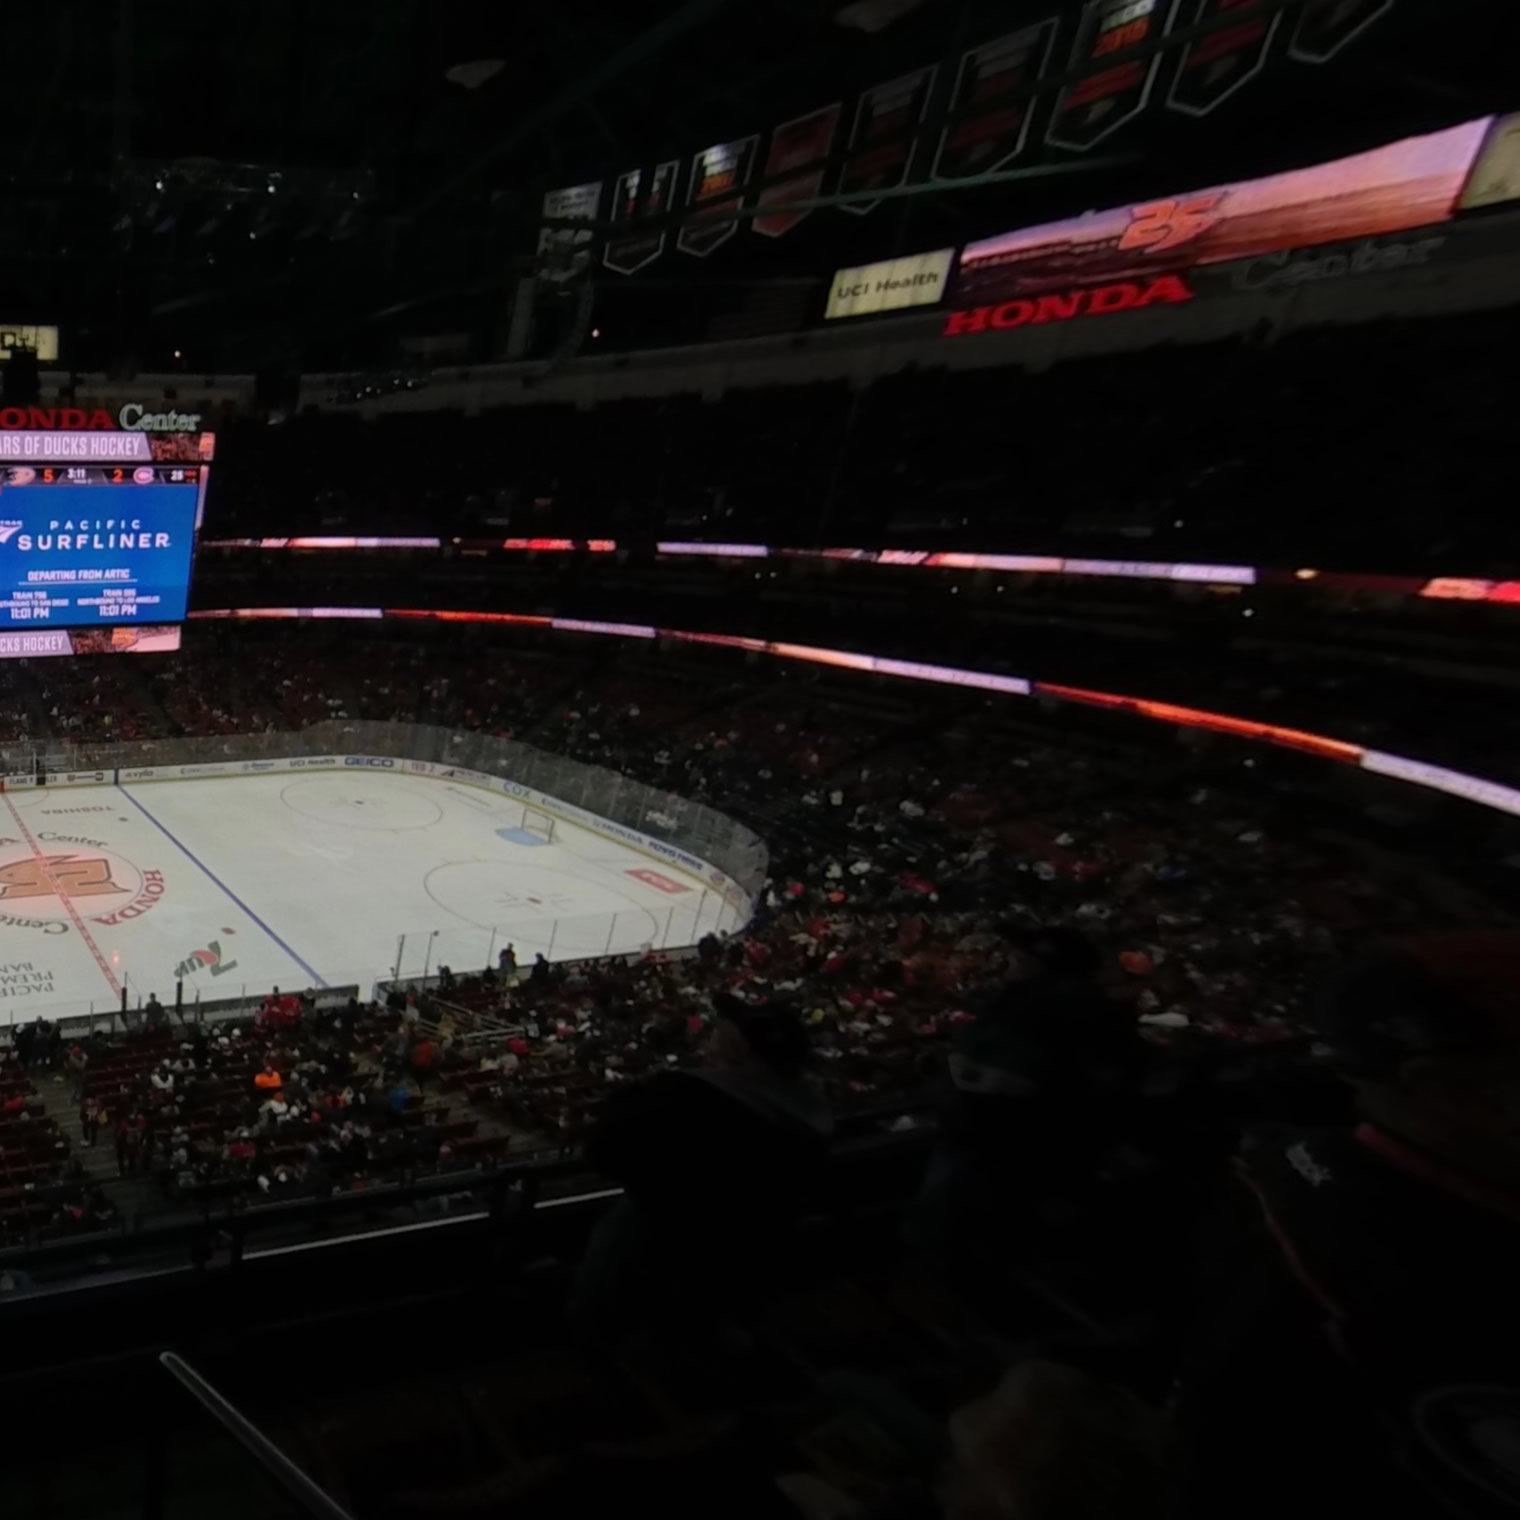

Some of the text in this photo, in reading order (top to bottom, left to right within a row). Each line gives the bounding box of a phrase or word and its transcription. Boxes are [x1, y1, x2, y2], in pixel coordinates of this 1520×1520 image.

[837, 270, 940, 300] UCI Health
[943, 275, 1195, 337] HONDA
[120, 403, 201, 431] Center
[25, 436, 39, 455] OF
[44, 436, 87, 455] DUCKS
[91, 436, 140, 456] HOCKEY
[43, 469, 54, 483] 5
[112, 469, 123, 484] 2
[50, 519, 141, 531] PACIFIC
[17, 533, 169, 551] SURFLINER
[28, 569, 130, 581] DEPARTING FROM ARTIC
[33, 607, 50, 619] PM
[121, 605, 137, 616] PM
[23, 635, 64, 652] HOCKEY
[345, 756, 394, 768] GEICO
[503, 781, 530, 799] COX
[41, 805, 115, 815] TOSHIBA
[37, 831, 109, 848] Center
[89, 869, 165, 926] HONDA
